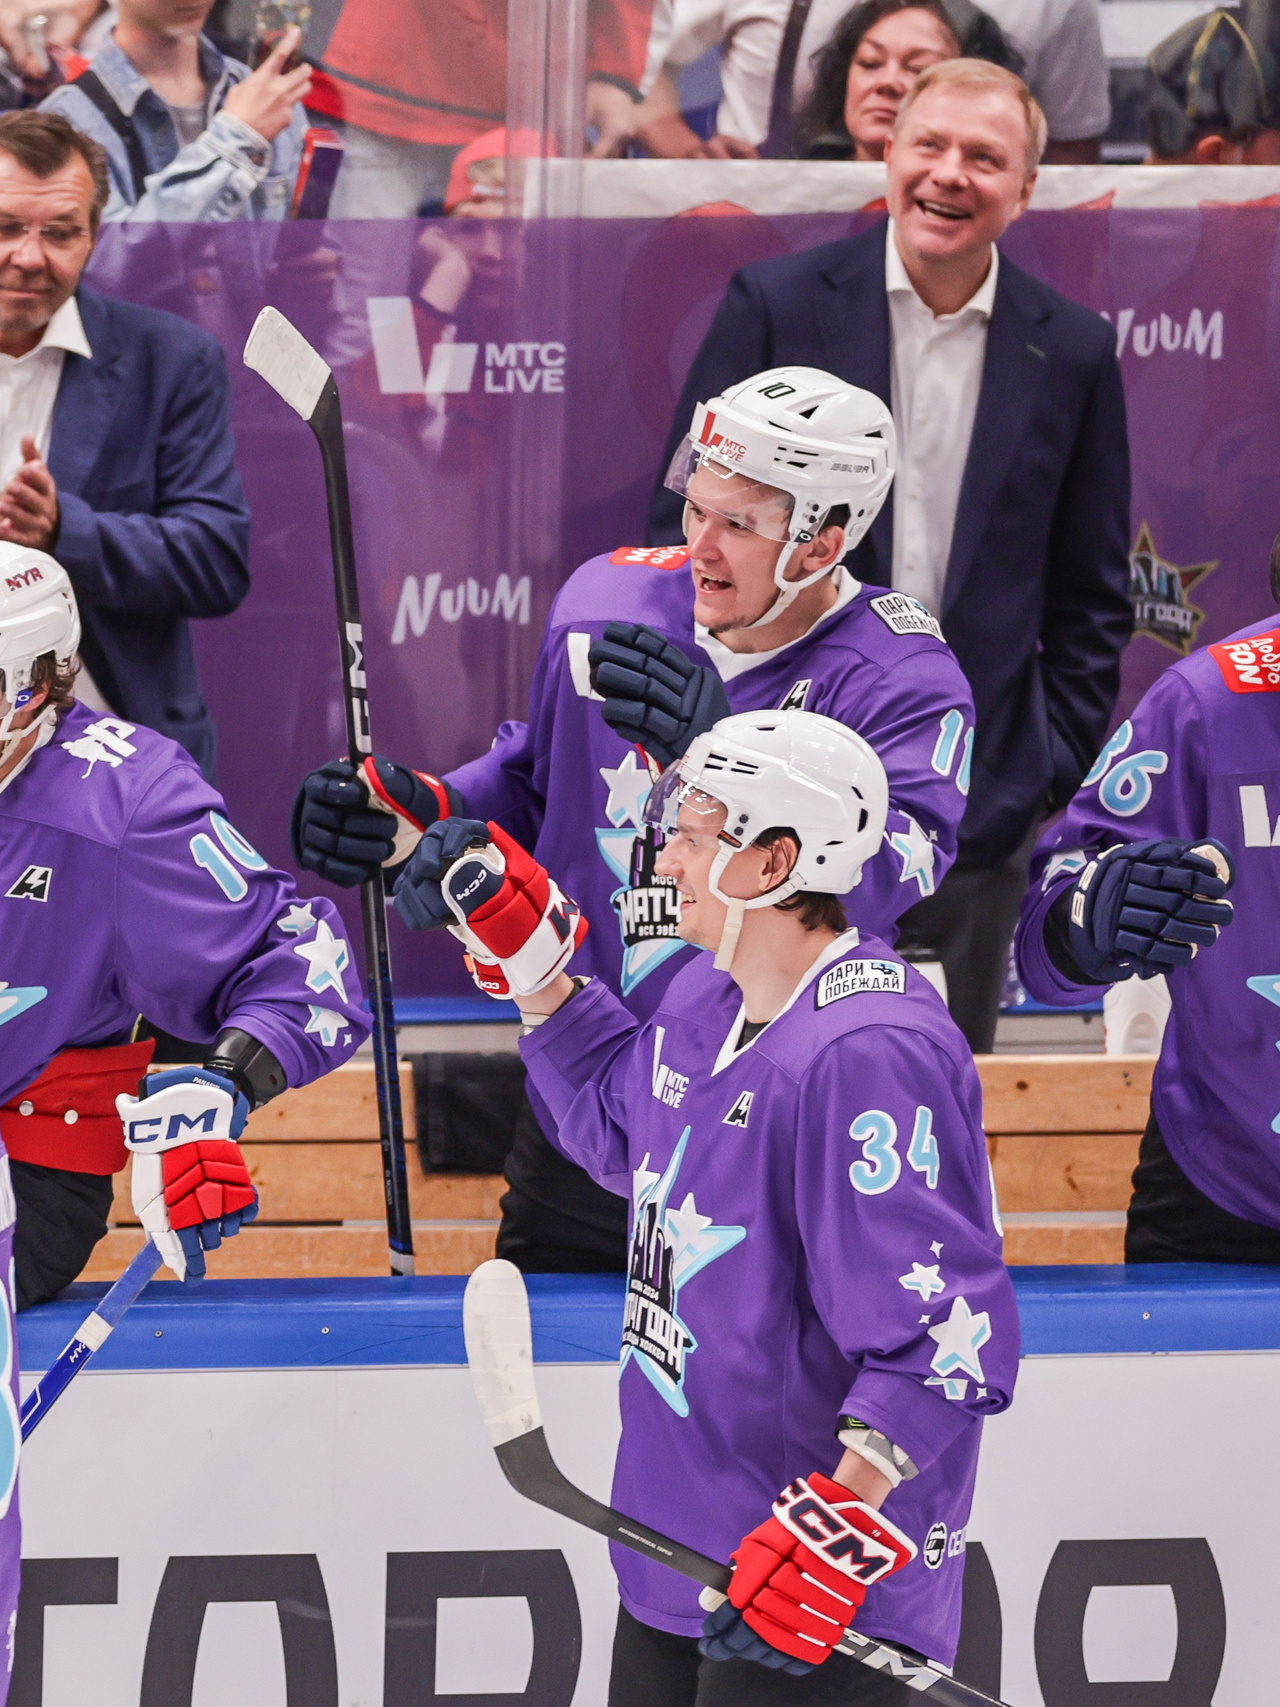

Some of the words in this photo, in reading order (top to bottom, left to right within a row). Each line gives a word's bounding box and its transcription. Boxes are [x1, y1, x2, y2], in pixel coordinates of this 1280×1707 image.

[485, 369, 566, 393] LIVE
[757, 382, 796, 399] 10
[5, 567, 44, 592] NYR
[1222, 642, 1264, 685] FON
[190, 810, 268, 902] 10
[455, 868, 488, 901] CCM
[825, 961, 865, 987] ПАРИ
[825, 974, 900, 1001] ПОБЕЖДАЙ
[662, 1086, 685, 1109] LIVE
[122, 1107, 219, 1144] CM
[848, 1105, 940, 1196] 34
